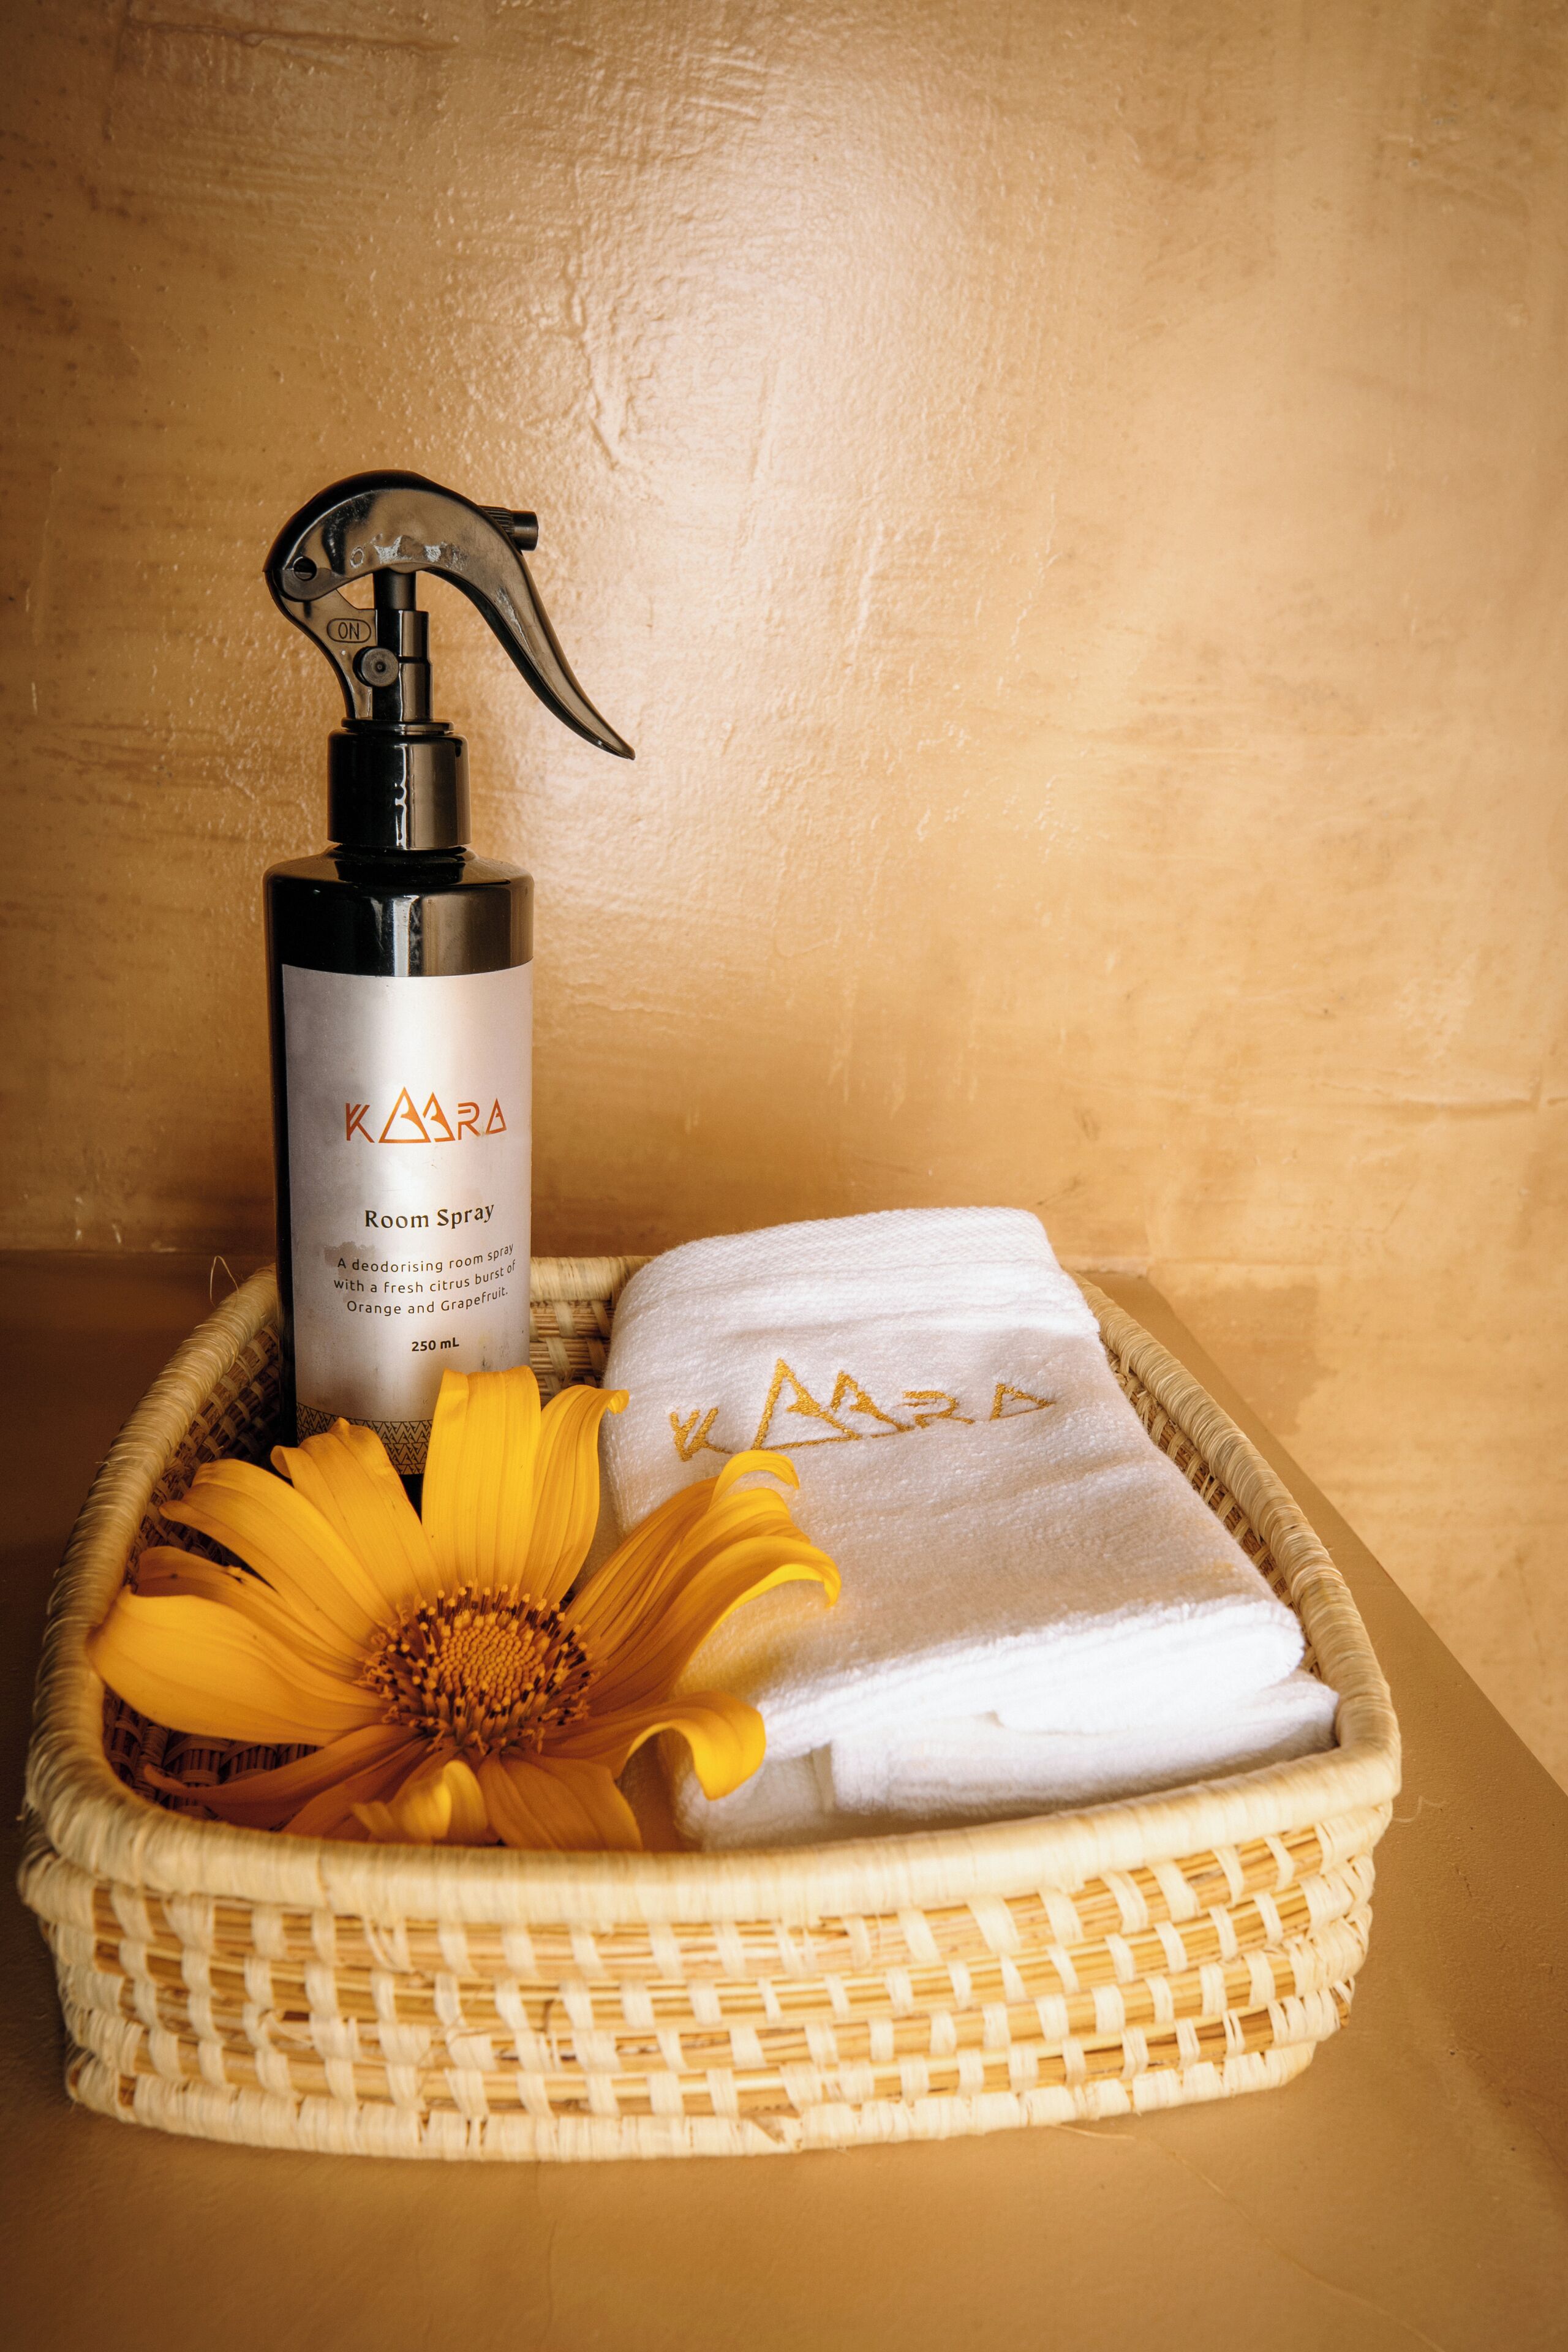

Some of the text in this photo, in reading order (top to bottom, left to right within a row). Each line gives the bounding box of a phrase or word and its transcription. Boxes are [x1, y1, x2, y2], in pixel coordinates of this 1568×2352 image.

[337, 622, 360, 639] ON
[345, 1086, 507, 1143] KAARA
[365, 1204, 495, 1229] Room Spray
[337, 1243, 514, 1273] A deodorising room spray
[334, 1260, 516, 1294] with a fresh citrus burst of
[347, 1286, 508, 1316] Orange and Grapefruit.
[412, 1337, 459, 1352] 250 mL
[669, 1357, 1057, 1463] KAARA
